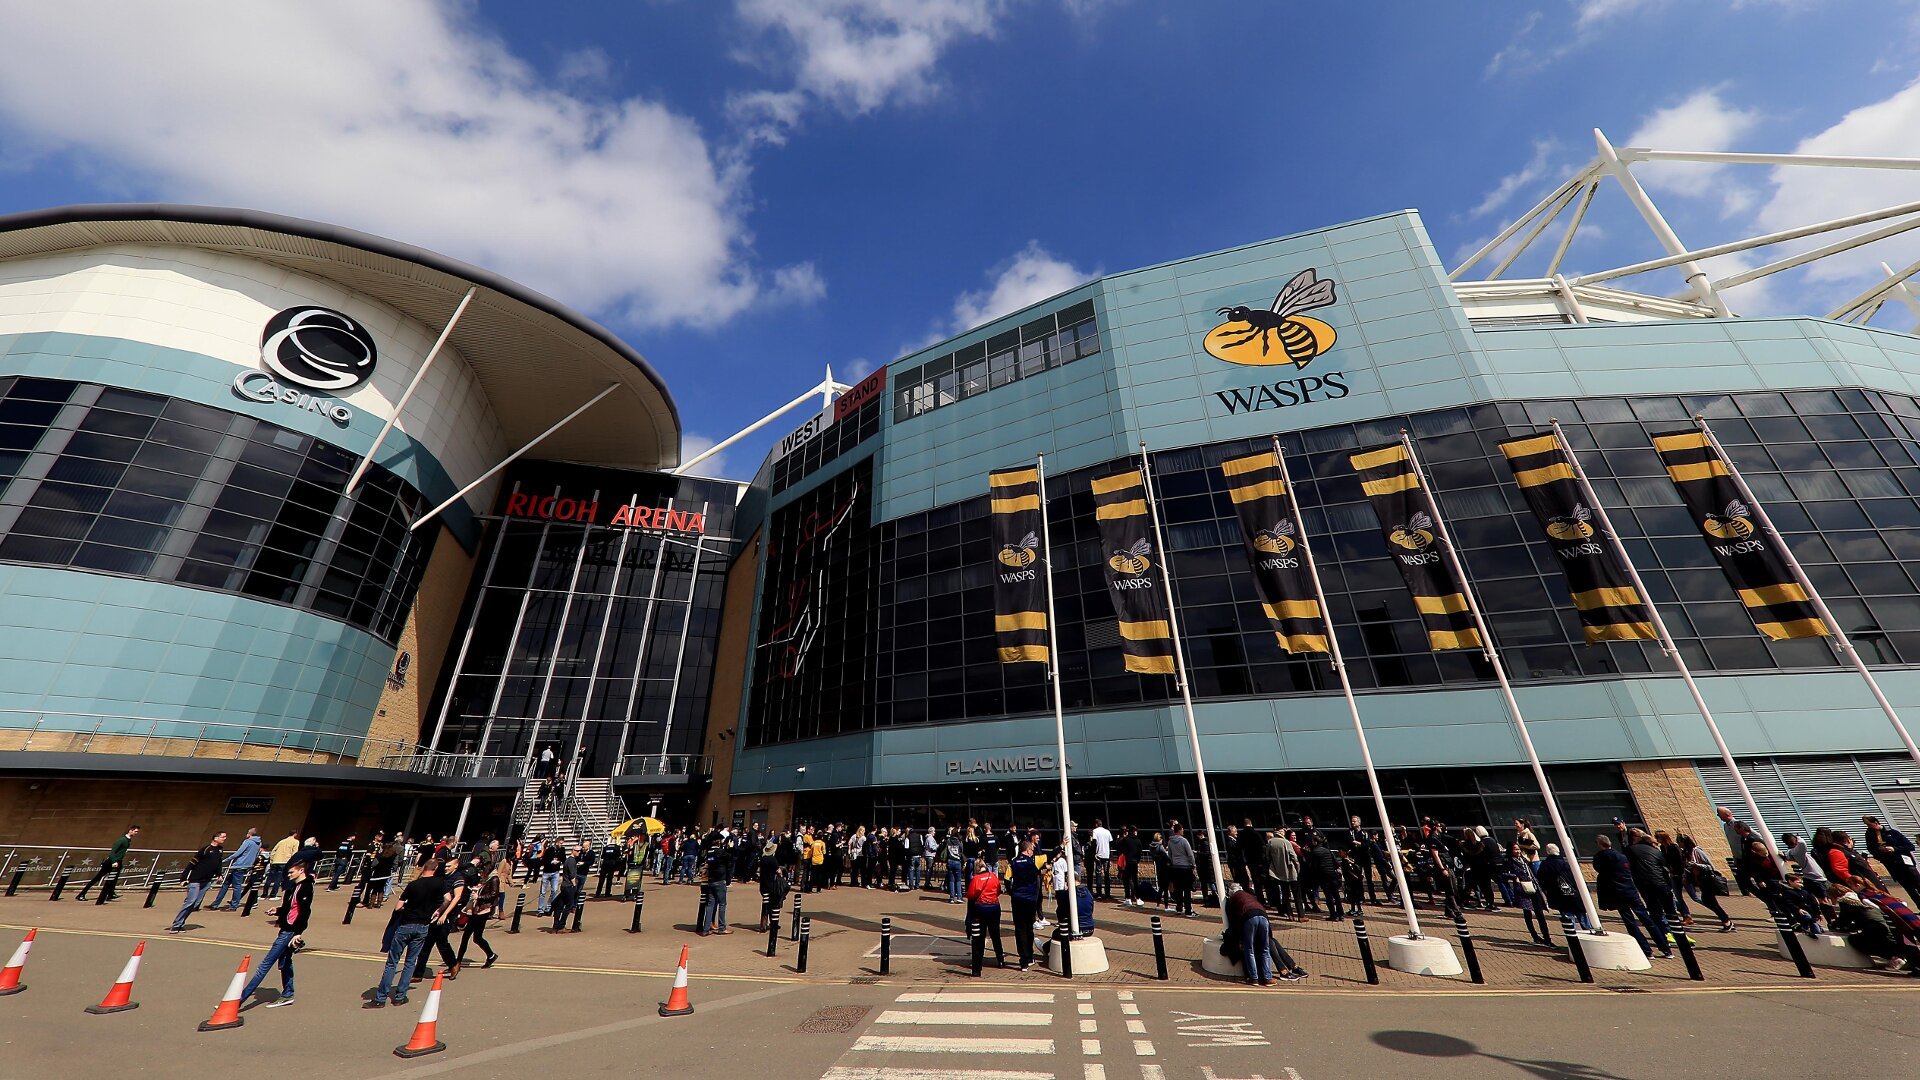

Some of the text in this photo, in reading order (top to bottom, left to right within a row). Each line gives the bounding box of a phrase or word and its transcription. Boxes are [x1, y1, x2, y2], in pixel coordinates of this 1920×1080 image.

[233, 369, 352, 423] CASINO
[1215, 371, 1350, 415] WASPS
[782, 377, 879, 455] WEST STAND
[505, 493, 705, 533] RICOH ARENA
[1558, 543, 1602, 559] WASPS
[1714, 540, 1764, 557] WASPS
[1259, 557, 1299, 570] WASPS
[1399, 551, 1440, 566] WASPS
[1000, 569, 1036, 584] WASPS
[1113, 577, 1152, 591] WASPS
[9, 864, 53, 873] Hneken
[1169, 1010, 1271, 1047] WAY
